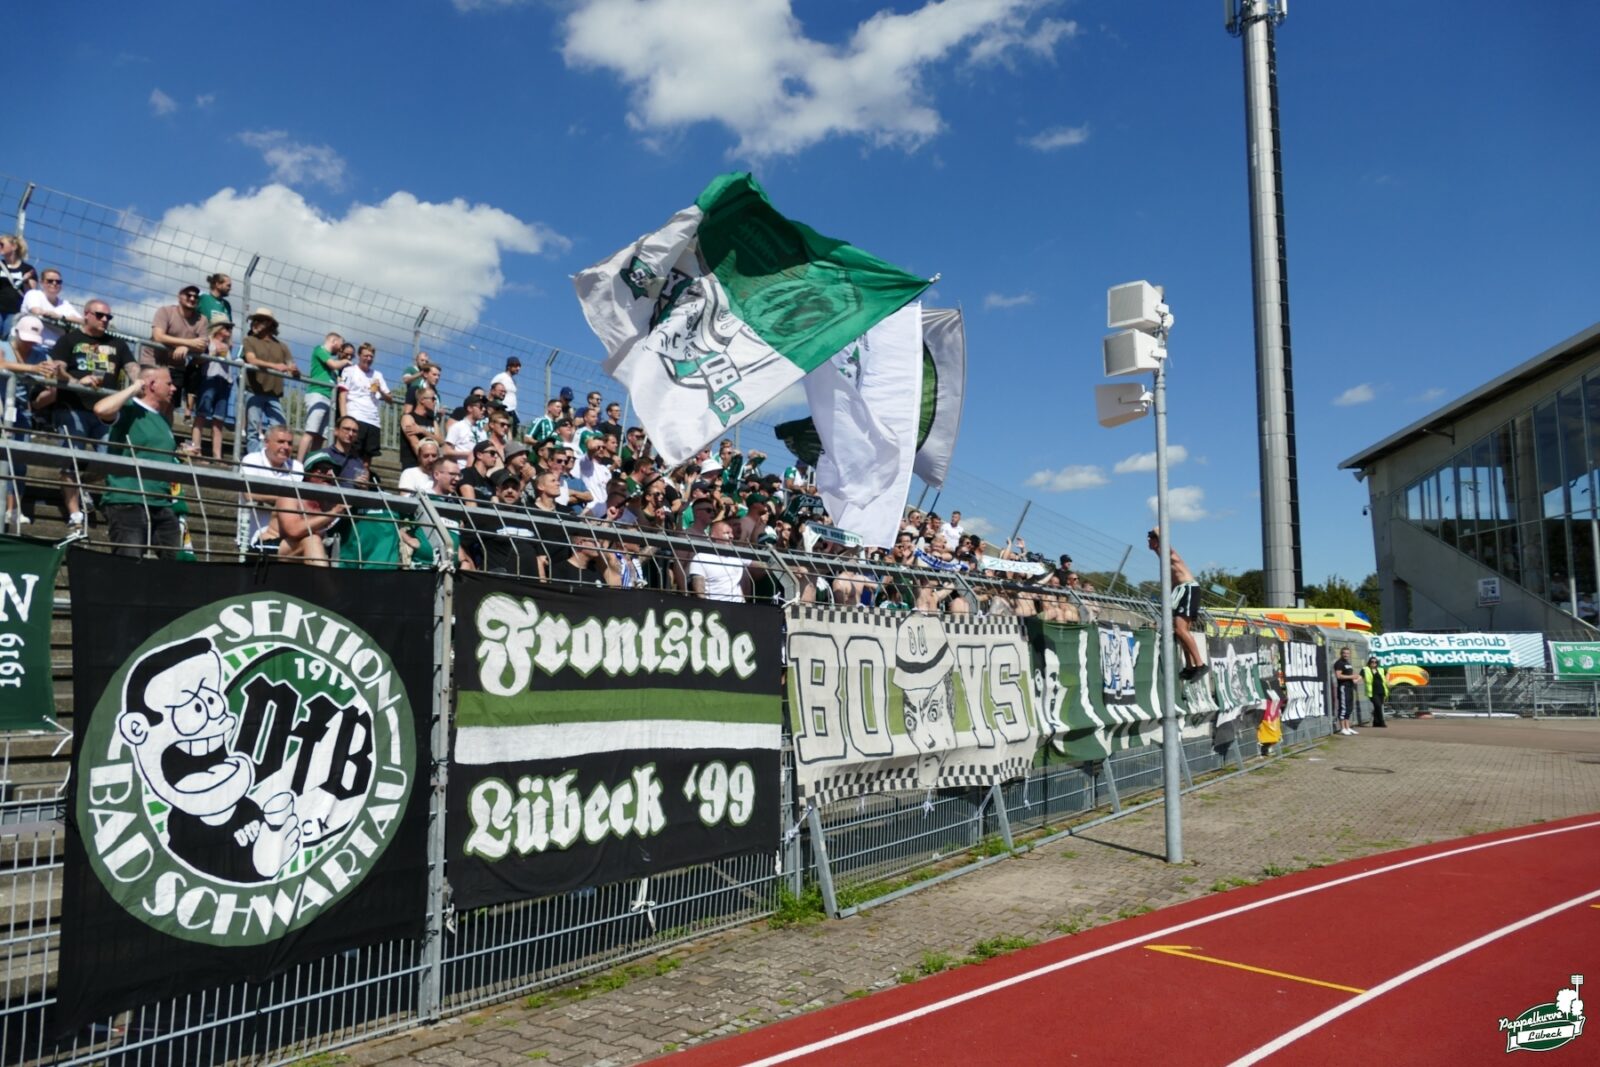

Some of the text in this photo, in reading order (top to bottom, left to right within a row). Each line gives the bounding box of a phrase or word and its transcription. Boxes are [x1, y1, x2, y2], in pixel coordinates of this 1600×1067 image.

[218, 600, 402, 710] SEKTION
[477, 593, 757, 697] Frontside
[1370, 651, 1519, 667] nchen-Nockherberg
[88, 762, 408, 936] BAD SCHWARTAU
[465, 763, 667, 861] Lübeck
